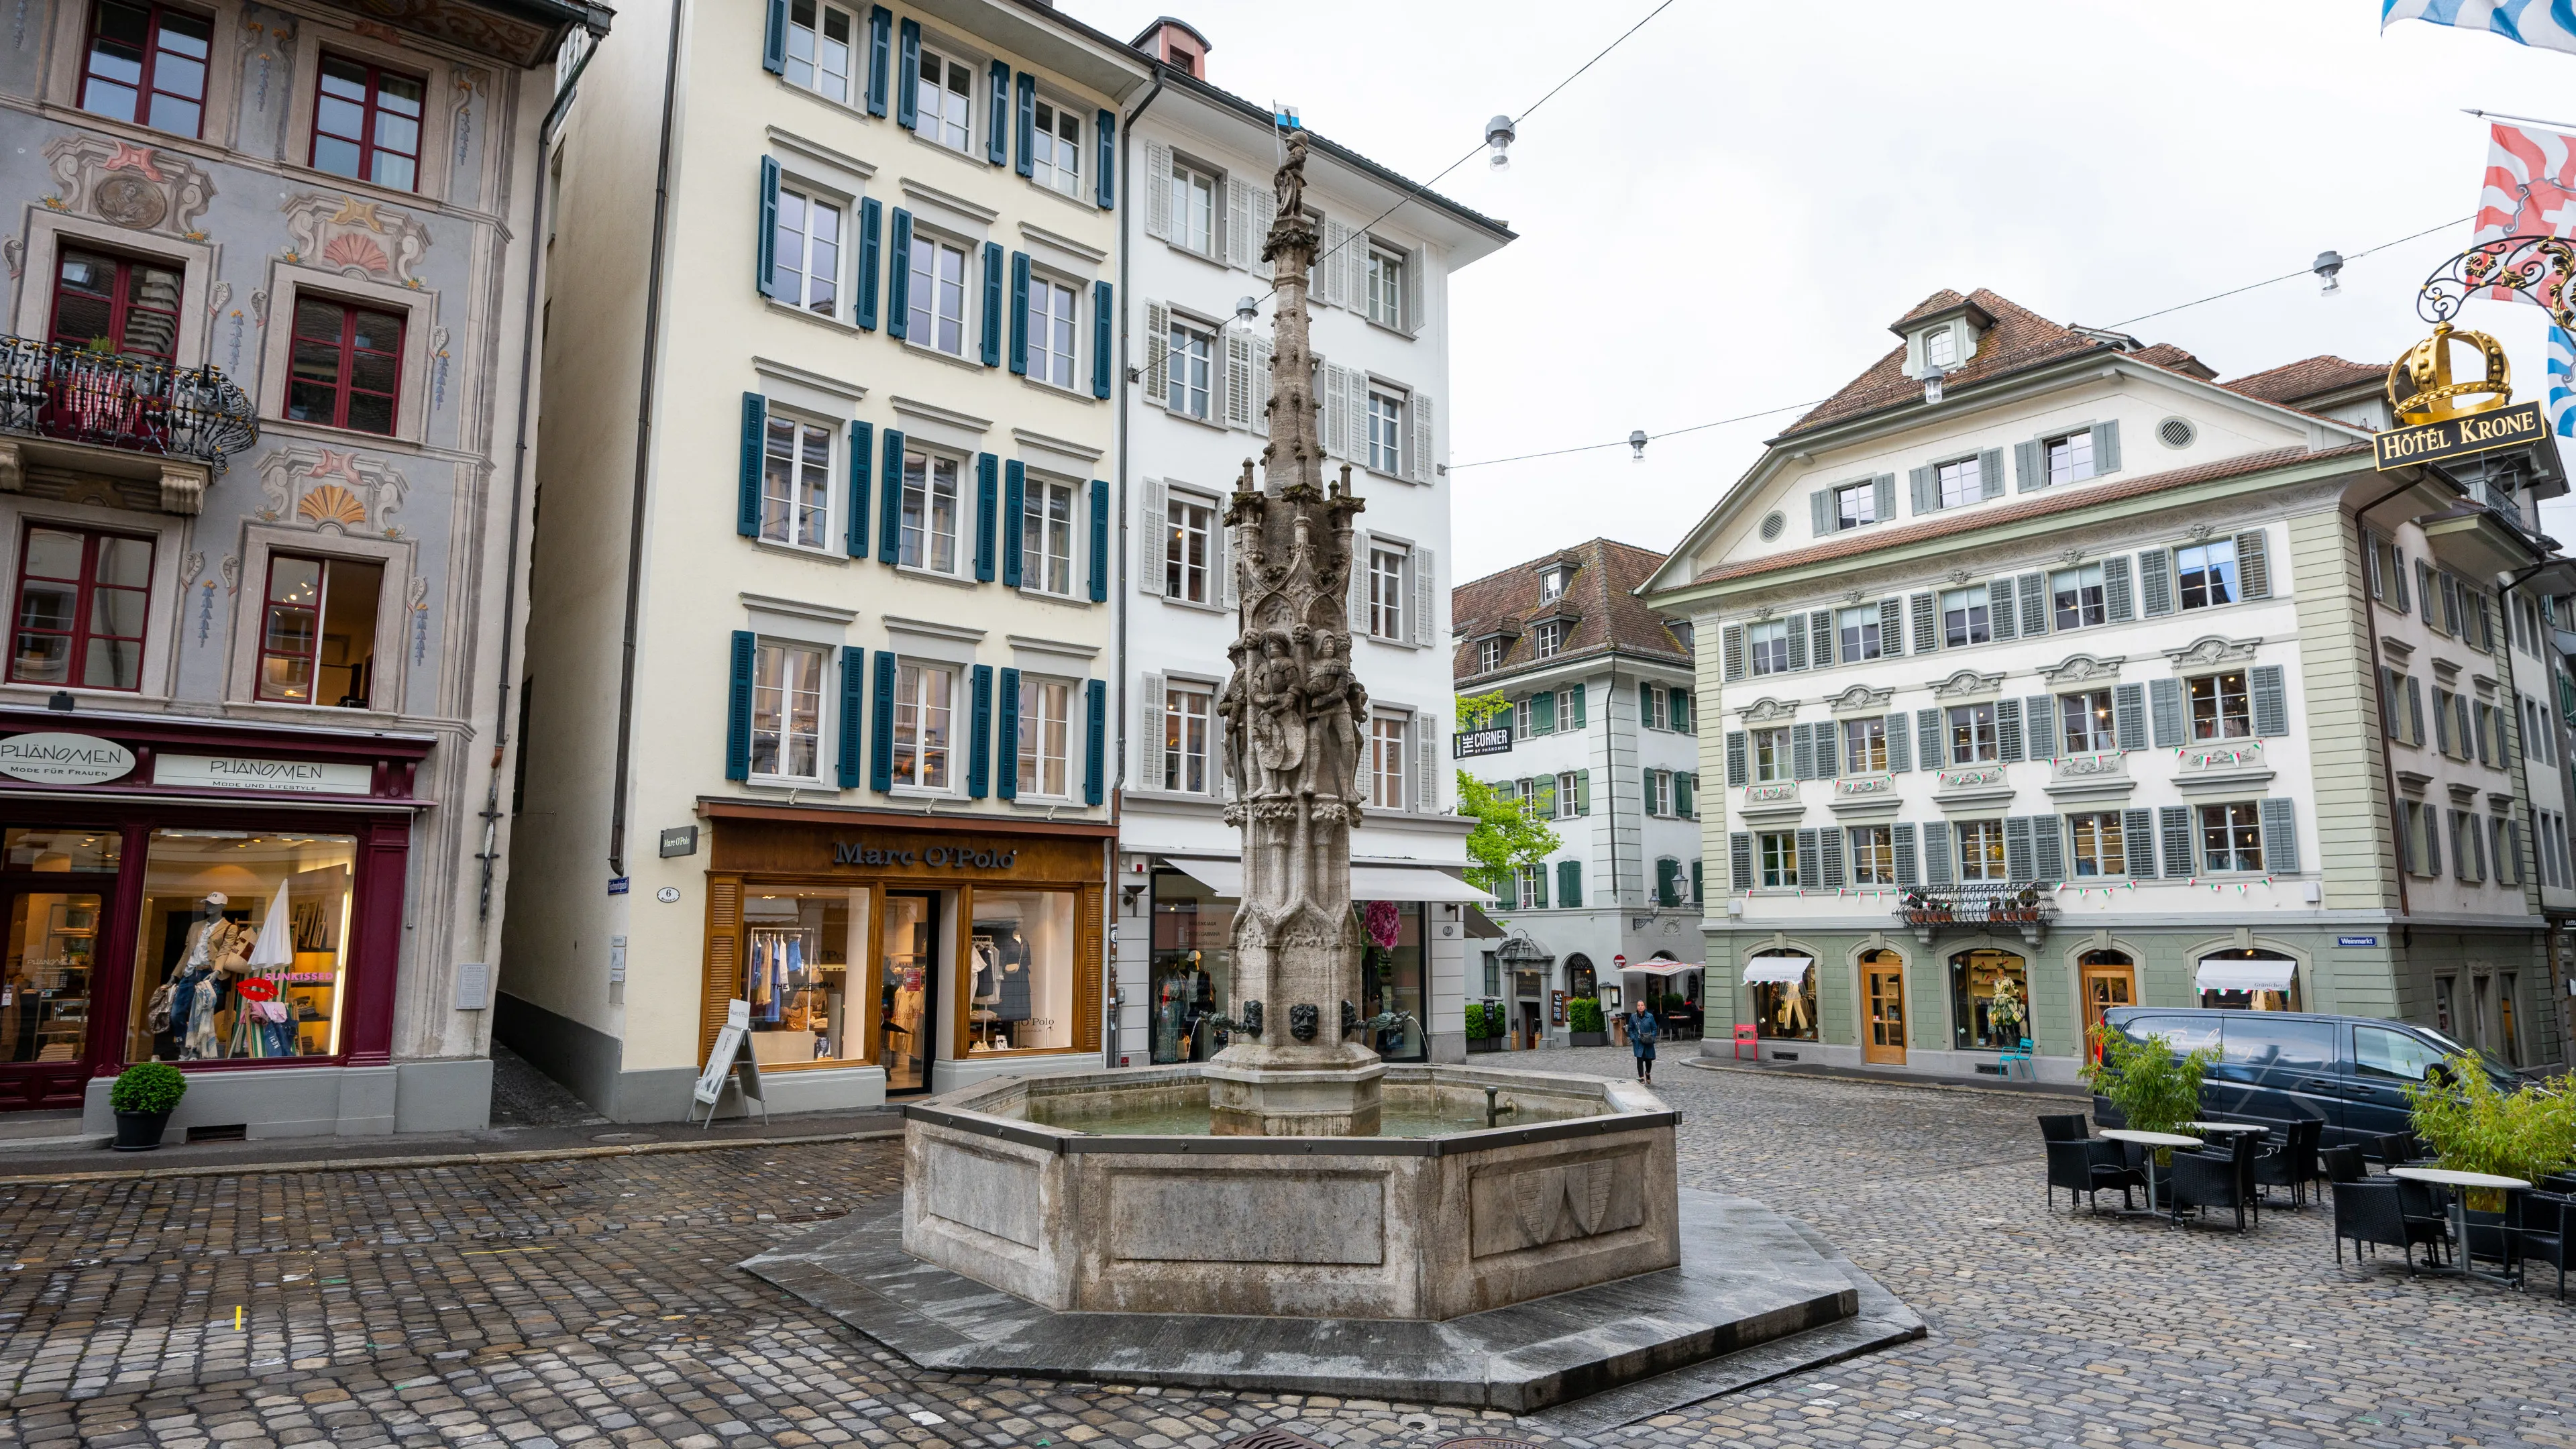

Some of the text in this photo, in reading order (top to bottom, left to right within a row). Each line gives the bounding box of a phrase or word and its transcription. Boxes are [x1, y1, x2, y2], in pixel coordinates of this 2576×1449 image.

[2458, 411, 2536, 444] KRONE
[1463, 729, 1507, 755] THE CORNER
[1, 743, 121, 765] PHÄNOMEN
[211, 759, 323, 780] PHÄNOMEN
[663, 836, 690, 847] Marc O'Polo
[833, 841, 1015, 869] Marc O'Polo
[666, 889, 672, 898] 6
[265, 972, 333, 981] SUNKISSED
[1021, 1018, 1055, 1026] OPolo
[269, 1036, 280, 1049] ICON
